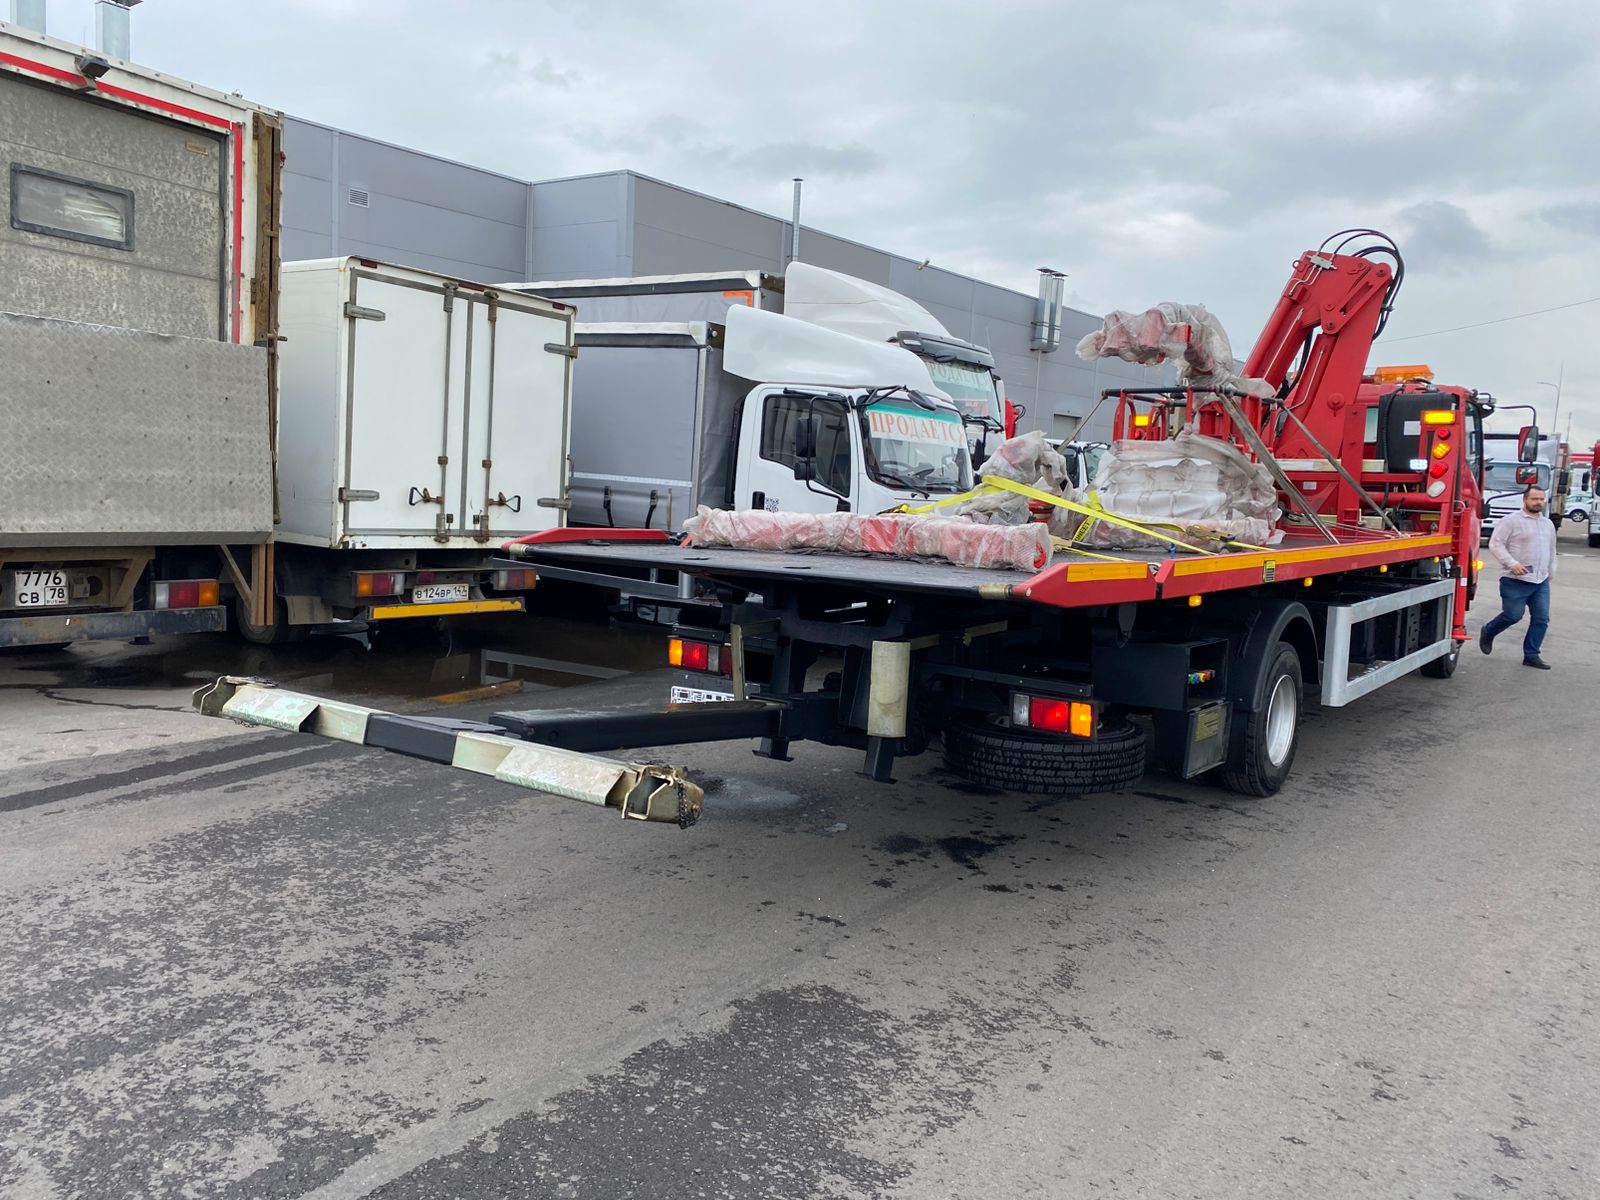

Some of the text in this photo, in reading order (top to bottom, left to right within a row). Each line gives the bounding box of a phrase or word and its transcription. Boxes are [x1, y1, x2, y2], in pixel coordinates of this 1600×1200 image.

[870, 411, 964, 445] ПРОДАЕТСЯ
[21, 571, 62, 587] 7776
[49, 588, 65, 599] 78
